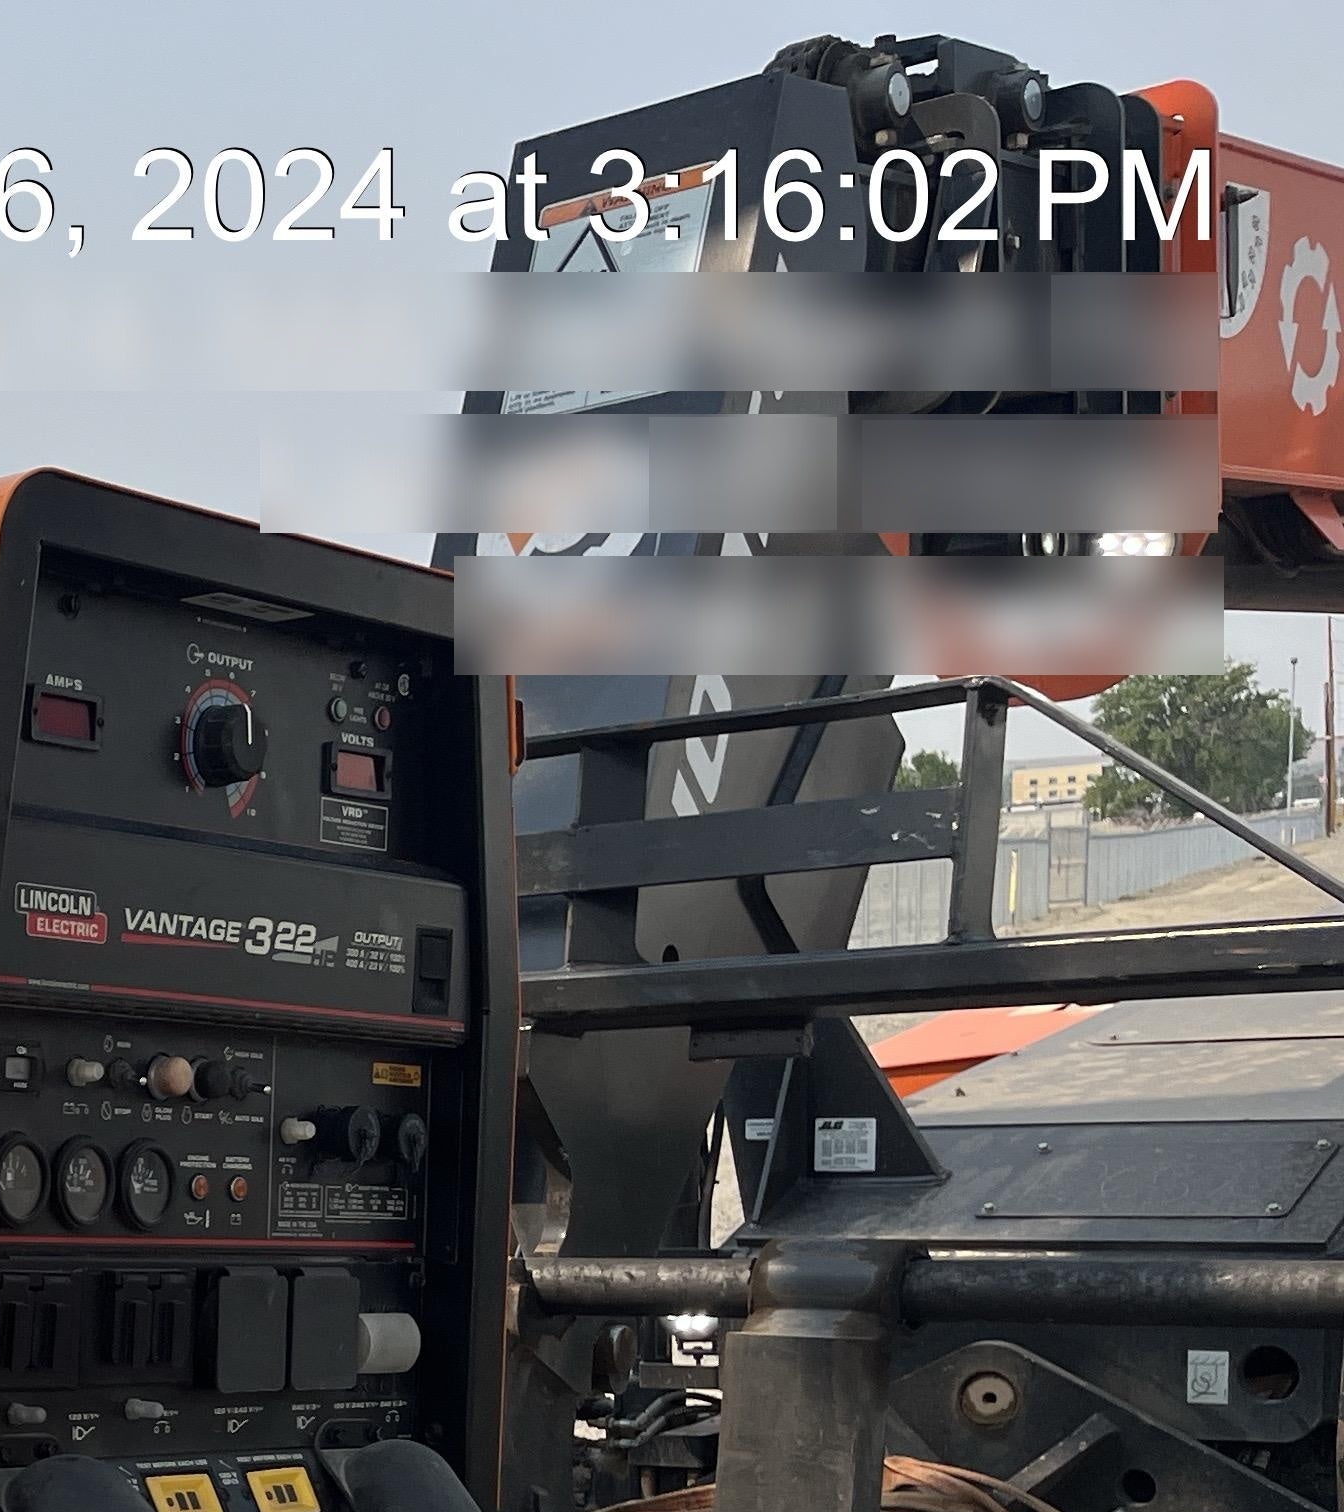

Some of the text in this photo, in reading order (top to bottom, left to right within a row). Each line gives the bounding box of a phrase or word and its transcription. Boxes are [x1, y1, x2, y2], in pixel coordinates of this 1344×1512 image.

[207, 652, 255, 671] OUTPUT
[45, 674, 83, 691] AMPS
[184, 685, 192, 694] 4
[175, 716, 181, 725] 3
[341, 732, 374, 748] VOLTS
[19, 888, 92, 916] LINCOLN
[35, 917, 100, 938] ELECTRIC
[122, 907, 318, 956] VANTAGE 322
[354, 931, 401, 948] OUTPUT
